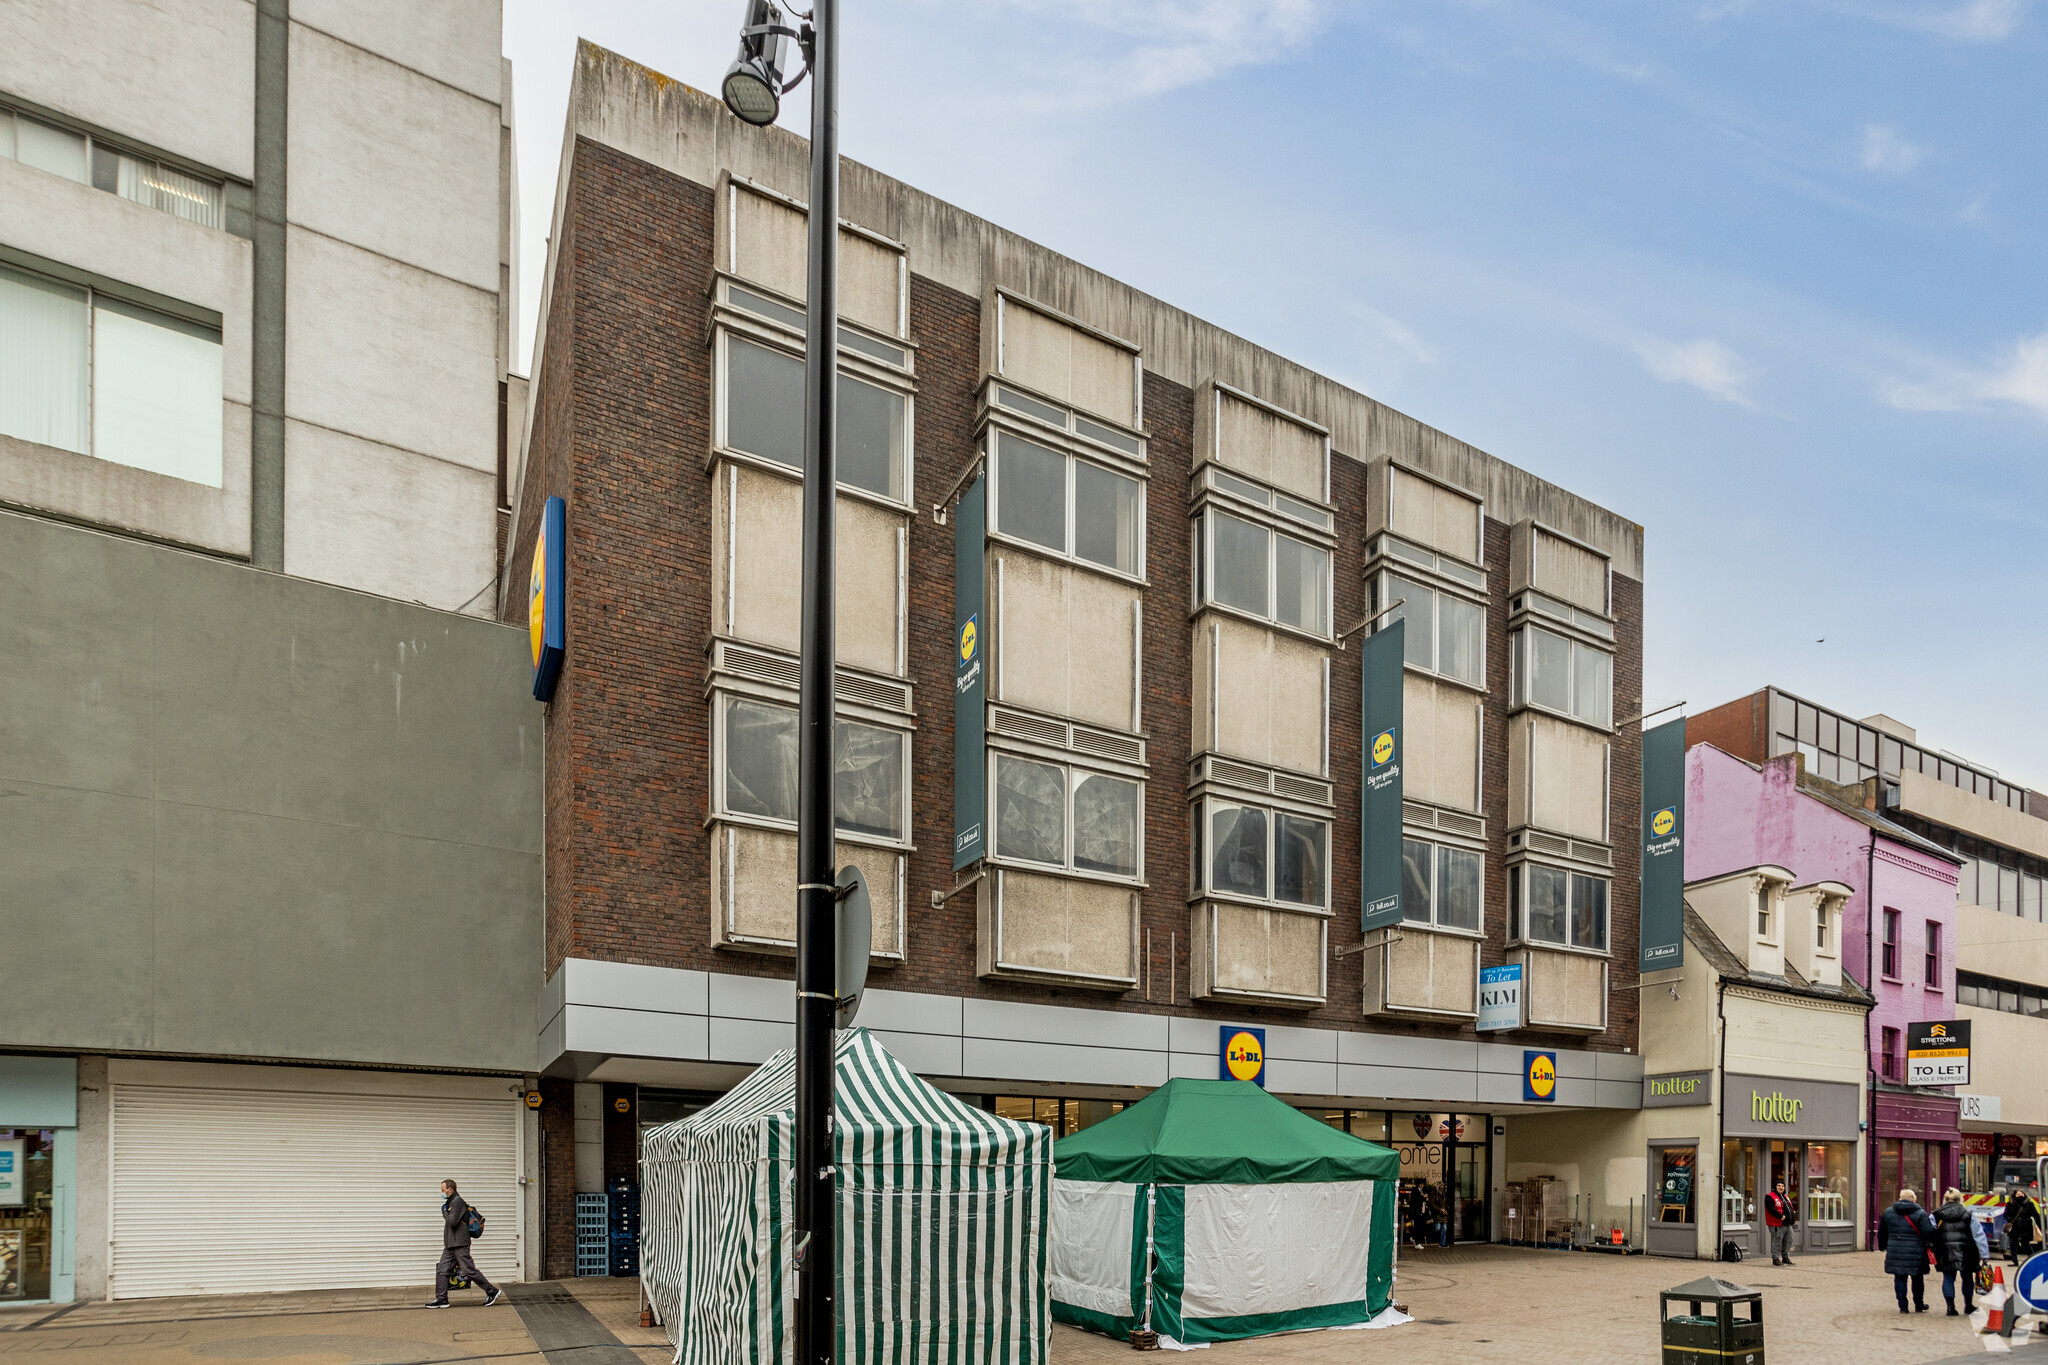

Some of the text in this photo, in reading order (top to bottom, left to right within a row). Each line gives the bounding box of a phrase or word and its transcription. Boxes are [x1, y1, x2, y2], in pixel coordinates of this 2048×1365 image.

[1647, 844, 1656, 853] Big
[1662, 836, 1680, 849] quality
[1655, 946, 1675, 955] lidl.co.uk
[1487, 974, 1496, 983] To
[1498, 972, 1511, 982] Let
[1481, 989, 1516, 1006] KLM
[1920, 1036, 1956, 1044] STRETTONS
[1913, 1065, 1965, 1075] TO LET
[1651, 1077, 1701, 1096] hotter
[1752, 1089, 1803, 1123] hotter
[1960, 1096, 1980, 1117] URS
[1965, 1138, 1987, 1151] OFFICE
[1392, 1146, 1441, 1165] ome
